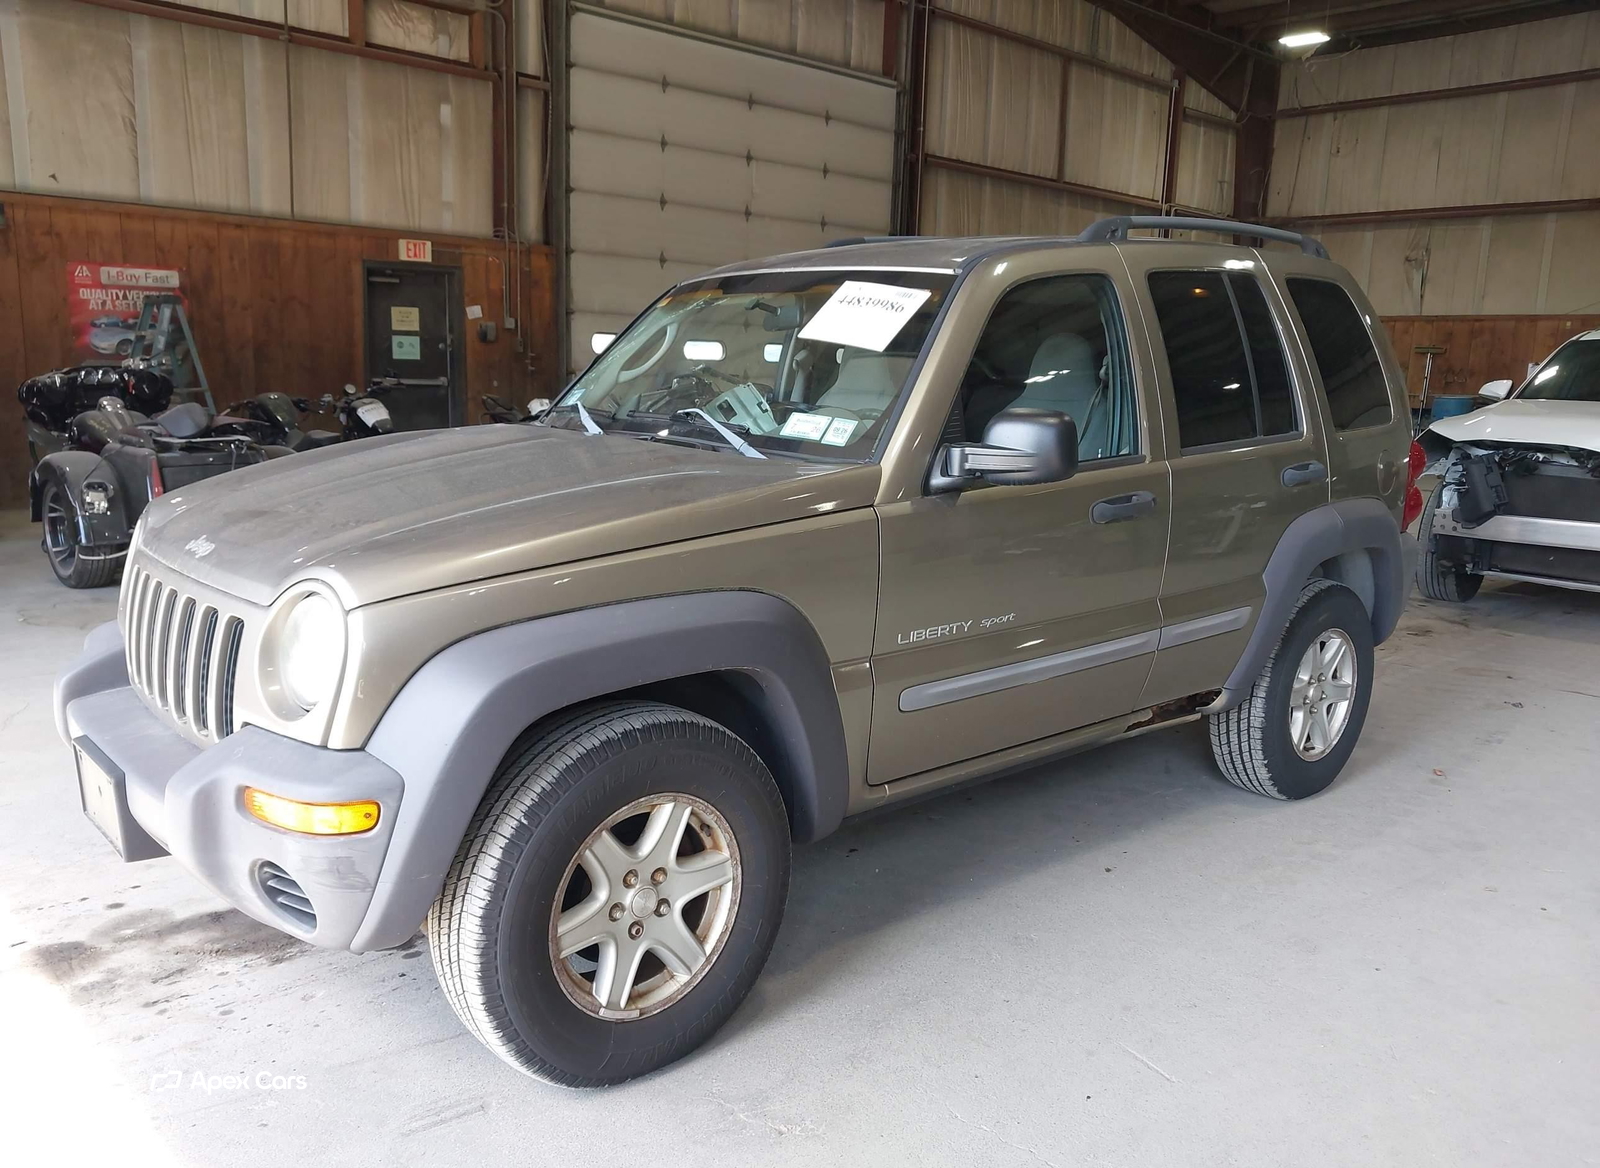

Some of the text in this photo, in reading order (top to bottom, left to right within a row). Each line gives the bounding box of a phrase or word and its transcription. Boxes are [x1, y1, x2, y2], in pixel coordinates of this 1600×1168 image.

[406, 241, 427, 259] EXIT
[107, 270, 140, 284] I-Buy
[144, 272, 170, 284] Fast
[79, 288, 125, 300] QUALITY
[89, 300, 102, 310] AT
[106, 301, 114, 311] A
[115, 301, 137, 312] SET
[897, 620, 973, 645] LIBERTY
